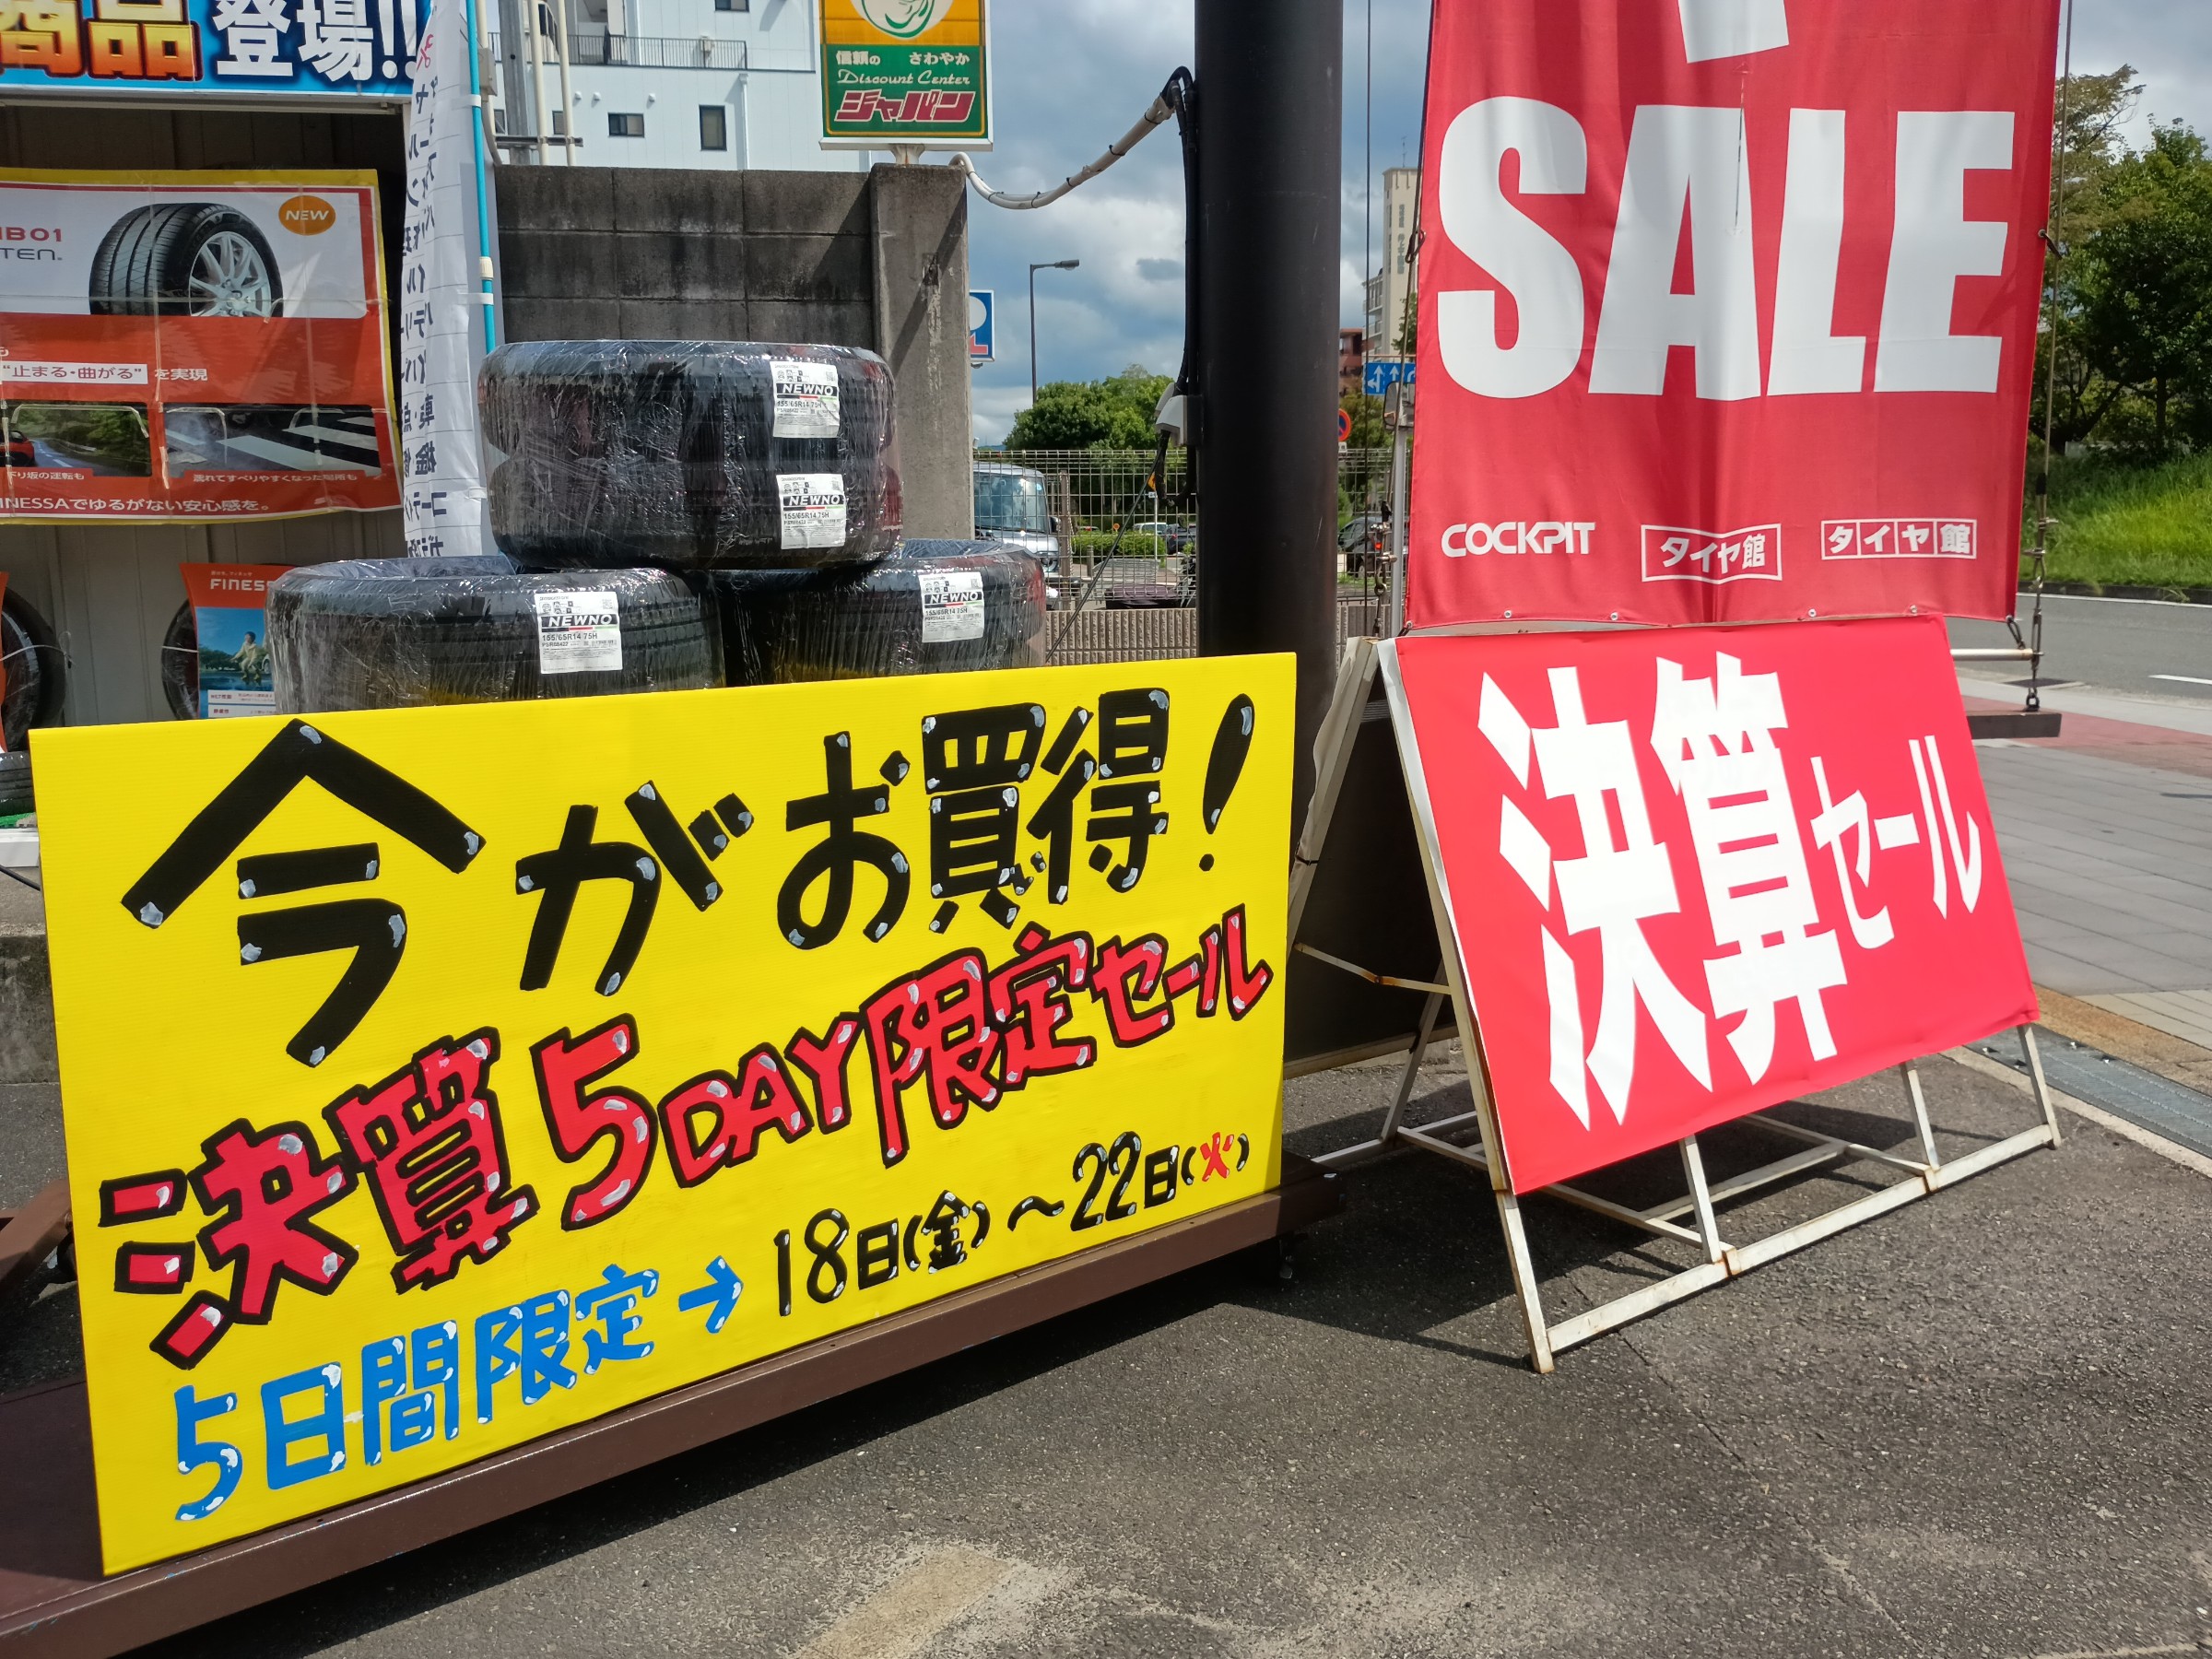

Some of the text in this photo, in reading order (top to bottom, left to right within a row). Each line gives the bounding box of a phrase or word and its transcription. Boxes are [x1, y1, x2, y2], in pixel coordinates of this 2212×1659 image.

[836, 51, 970, 65] 信頼の さわやか
[837, 69, 971, 85] Discount Center
[286, 210, 329, 220] NEW
[0, 227, 62, 241] B01
[1438, 96, 2014, 399] SALE
[155, 368, 208, 381] を実現
[782, 383, 834, 396] NEWNO
[789, 495, 841, 506] NEWNO
[1441, 521, 1595, 558] COCKPIT
[1828, 524, 1971, 554] タイヤ館
[1660, 533, 1766, 575] タイヤ館
[210, 578, 275, 591] FINES
[930, 592, 978, 604] NEWNO
[548, 614, 613, 627] NEWNO
[542, 633, 582, 641] 155/65R14
[121, 687, 1254, 1068] 今がお買得!
[1477, 651, 1983, 1132] 決算セール
[175, 1264, 659, 1521] 5日間限定
